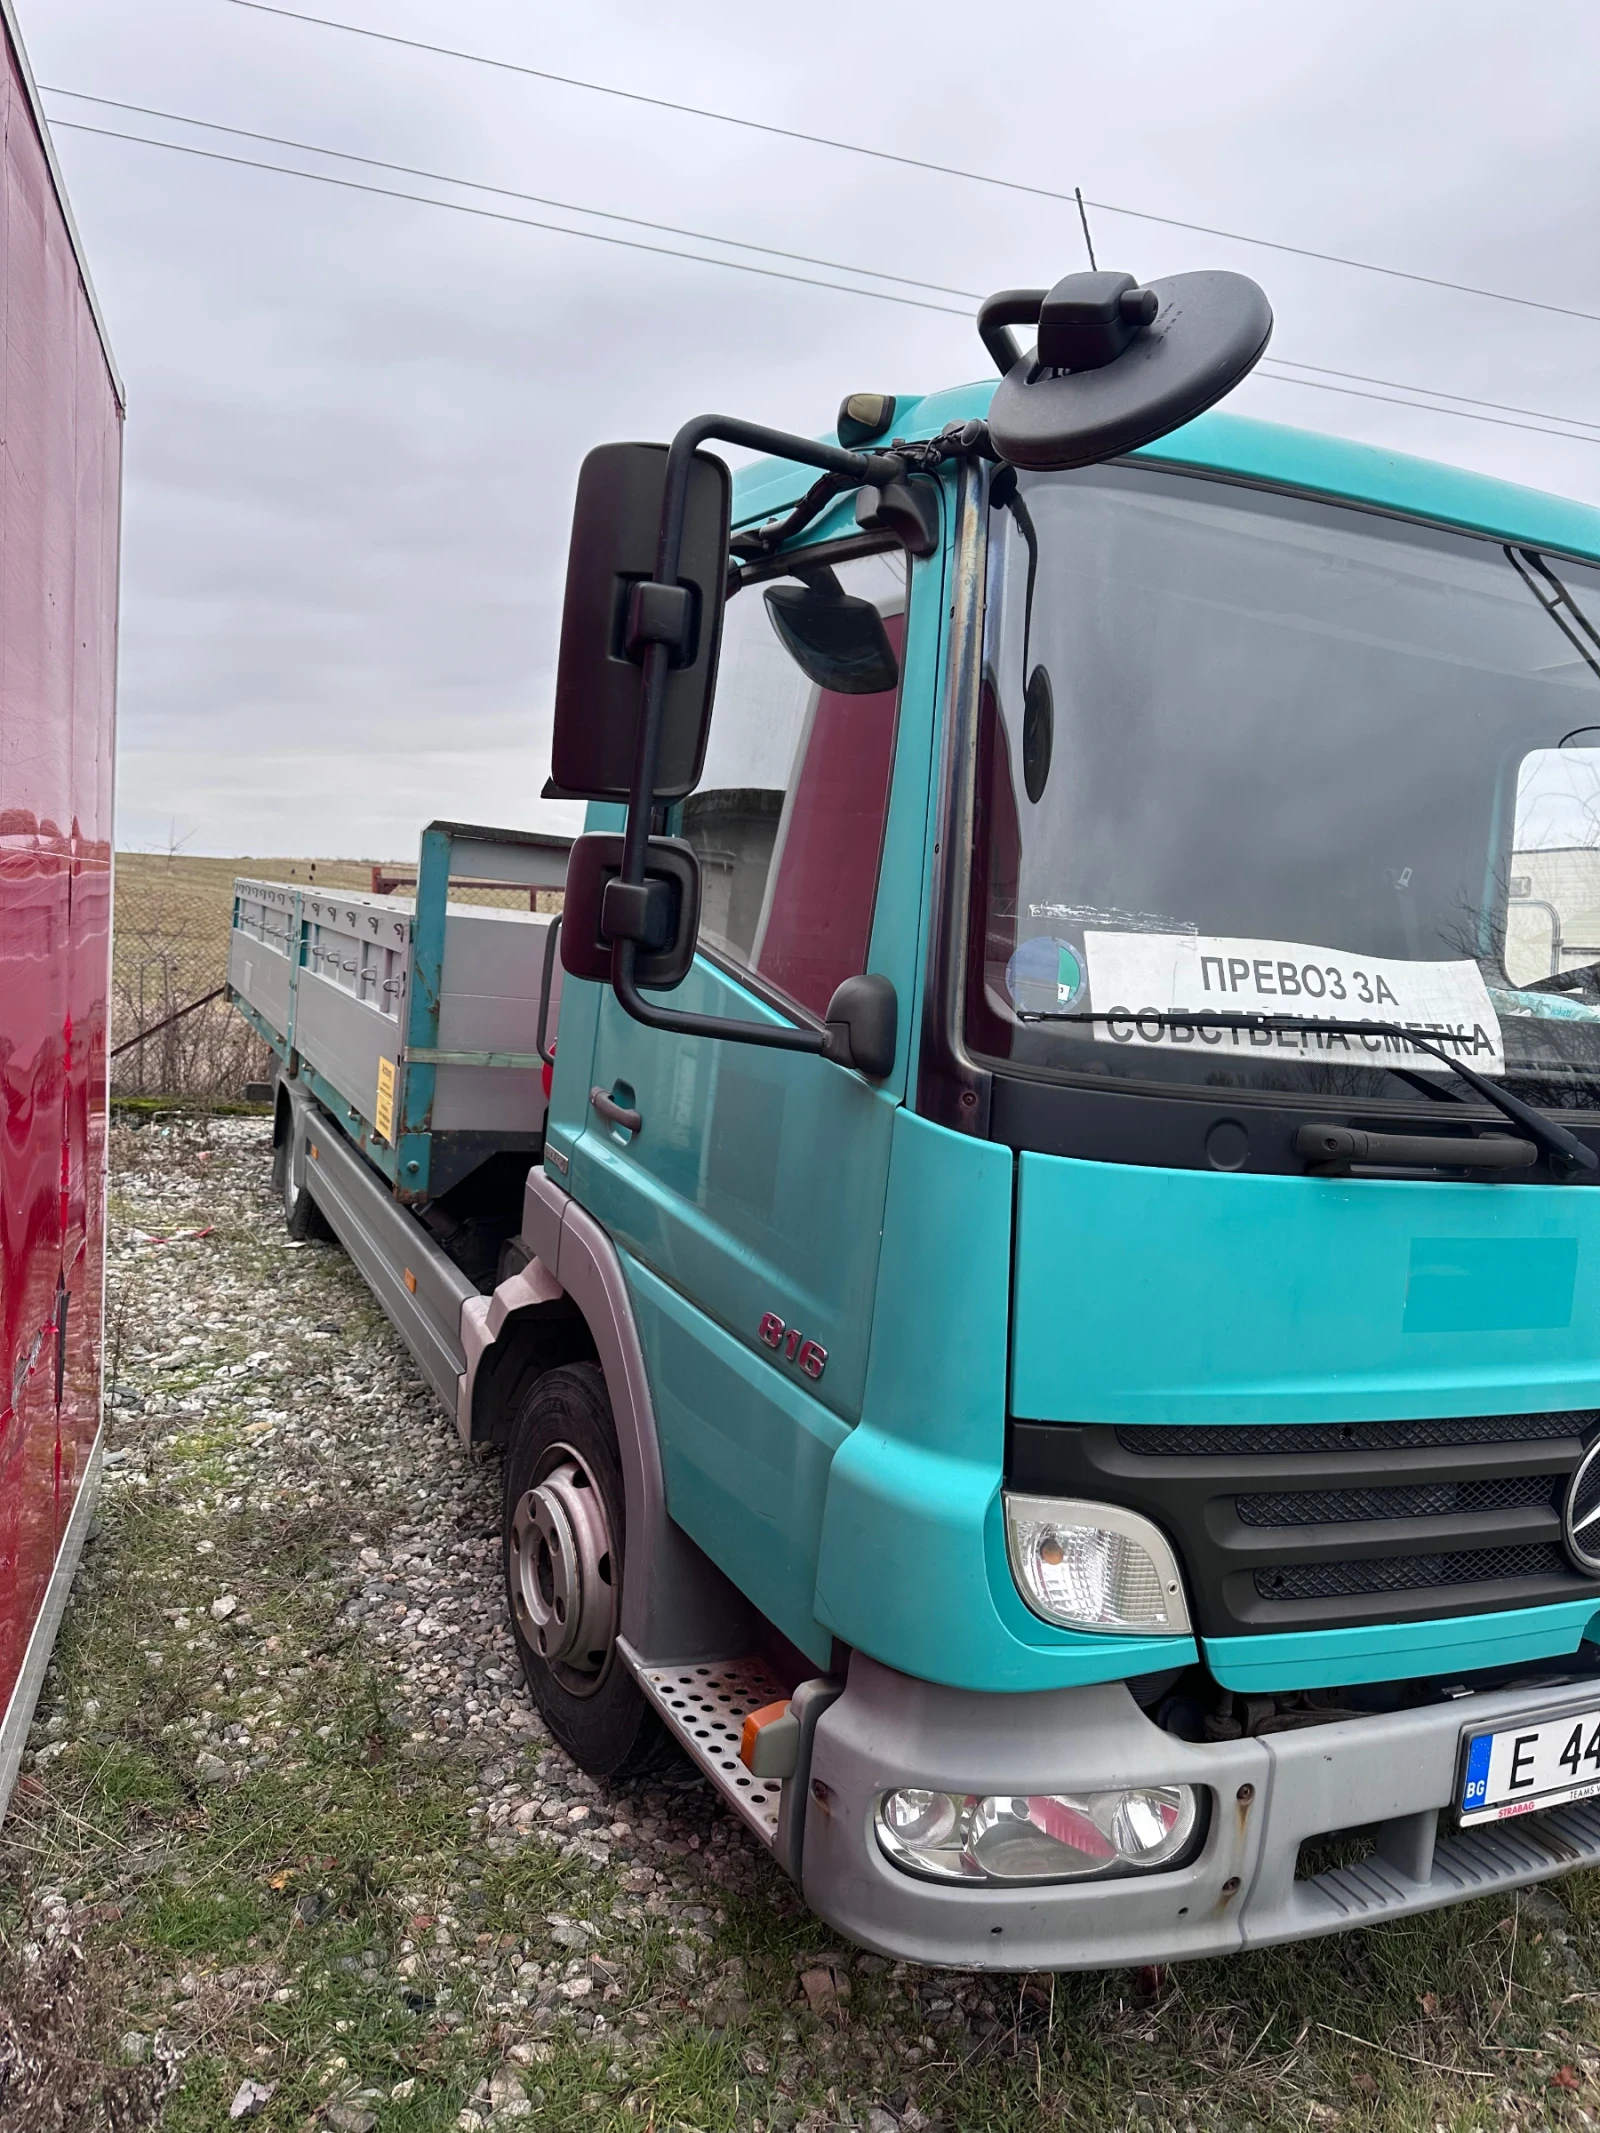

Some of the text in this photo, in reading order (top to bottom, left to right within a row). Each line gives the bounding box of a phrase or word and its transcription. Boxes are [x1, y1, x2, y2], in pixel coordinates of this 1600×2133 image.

[1200, 956, 1399, 1006] ПРЕВОЗ ЗА
[758, 1311, 828, 1378] 816
[1509, 1722, 1600, 1790] E 44
[1466, 1780, 1485, 1798] BG
[1498, 1801, 1535, 1818] STRABAG
[1569, 1786, 1594, 1799] TEAMS
